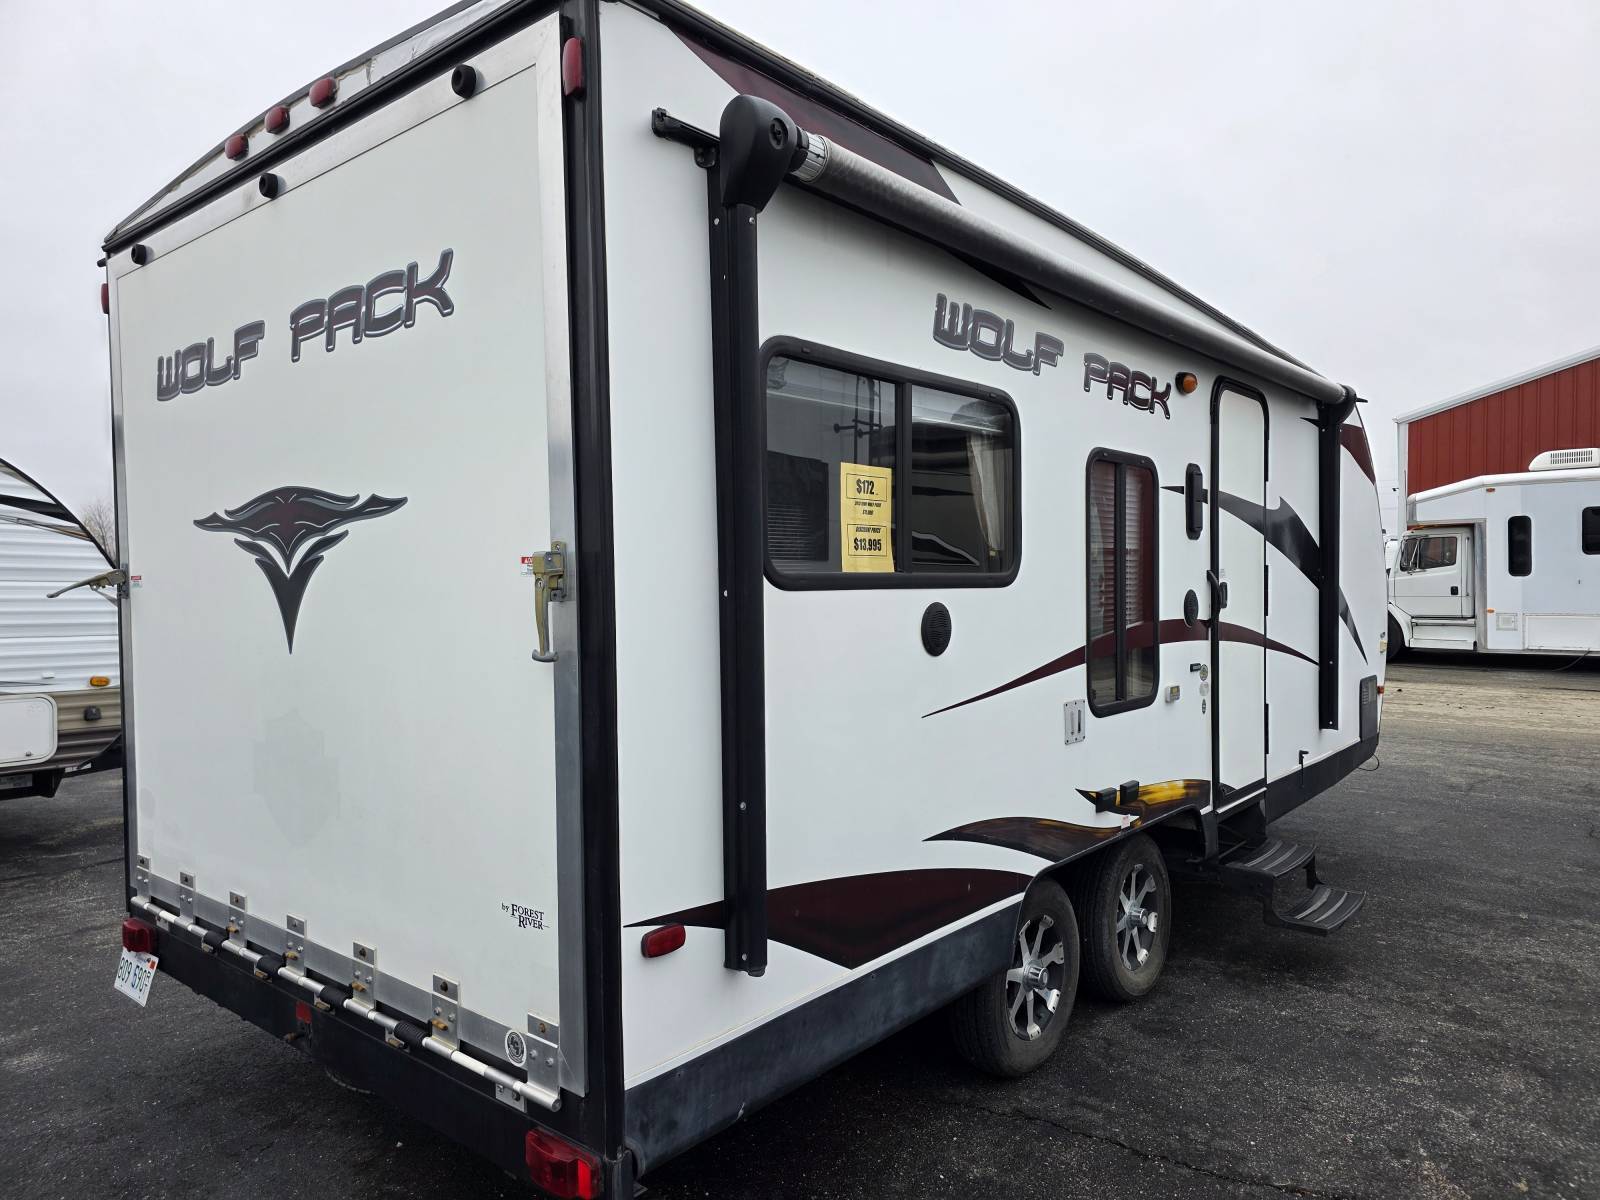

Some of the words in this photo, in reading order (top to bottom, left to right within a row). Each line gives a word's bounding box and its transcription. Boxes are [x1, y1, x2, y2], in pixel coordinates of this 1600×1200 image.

[157, 320, 265, 401] WOLF
[289, 247, 454, 363] PACK
[932, 292, 1064, 376] WOLF
[1083, 352, 1171, 420] PACK
[856, 478, 875, 495] $172
[854, 537, 882, 552] $13,995
[511, 903, 545, 921] FOREST
[518, 914, 544, 930] RIVER
